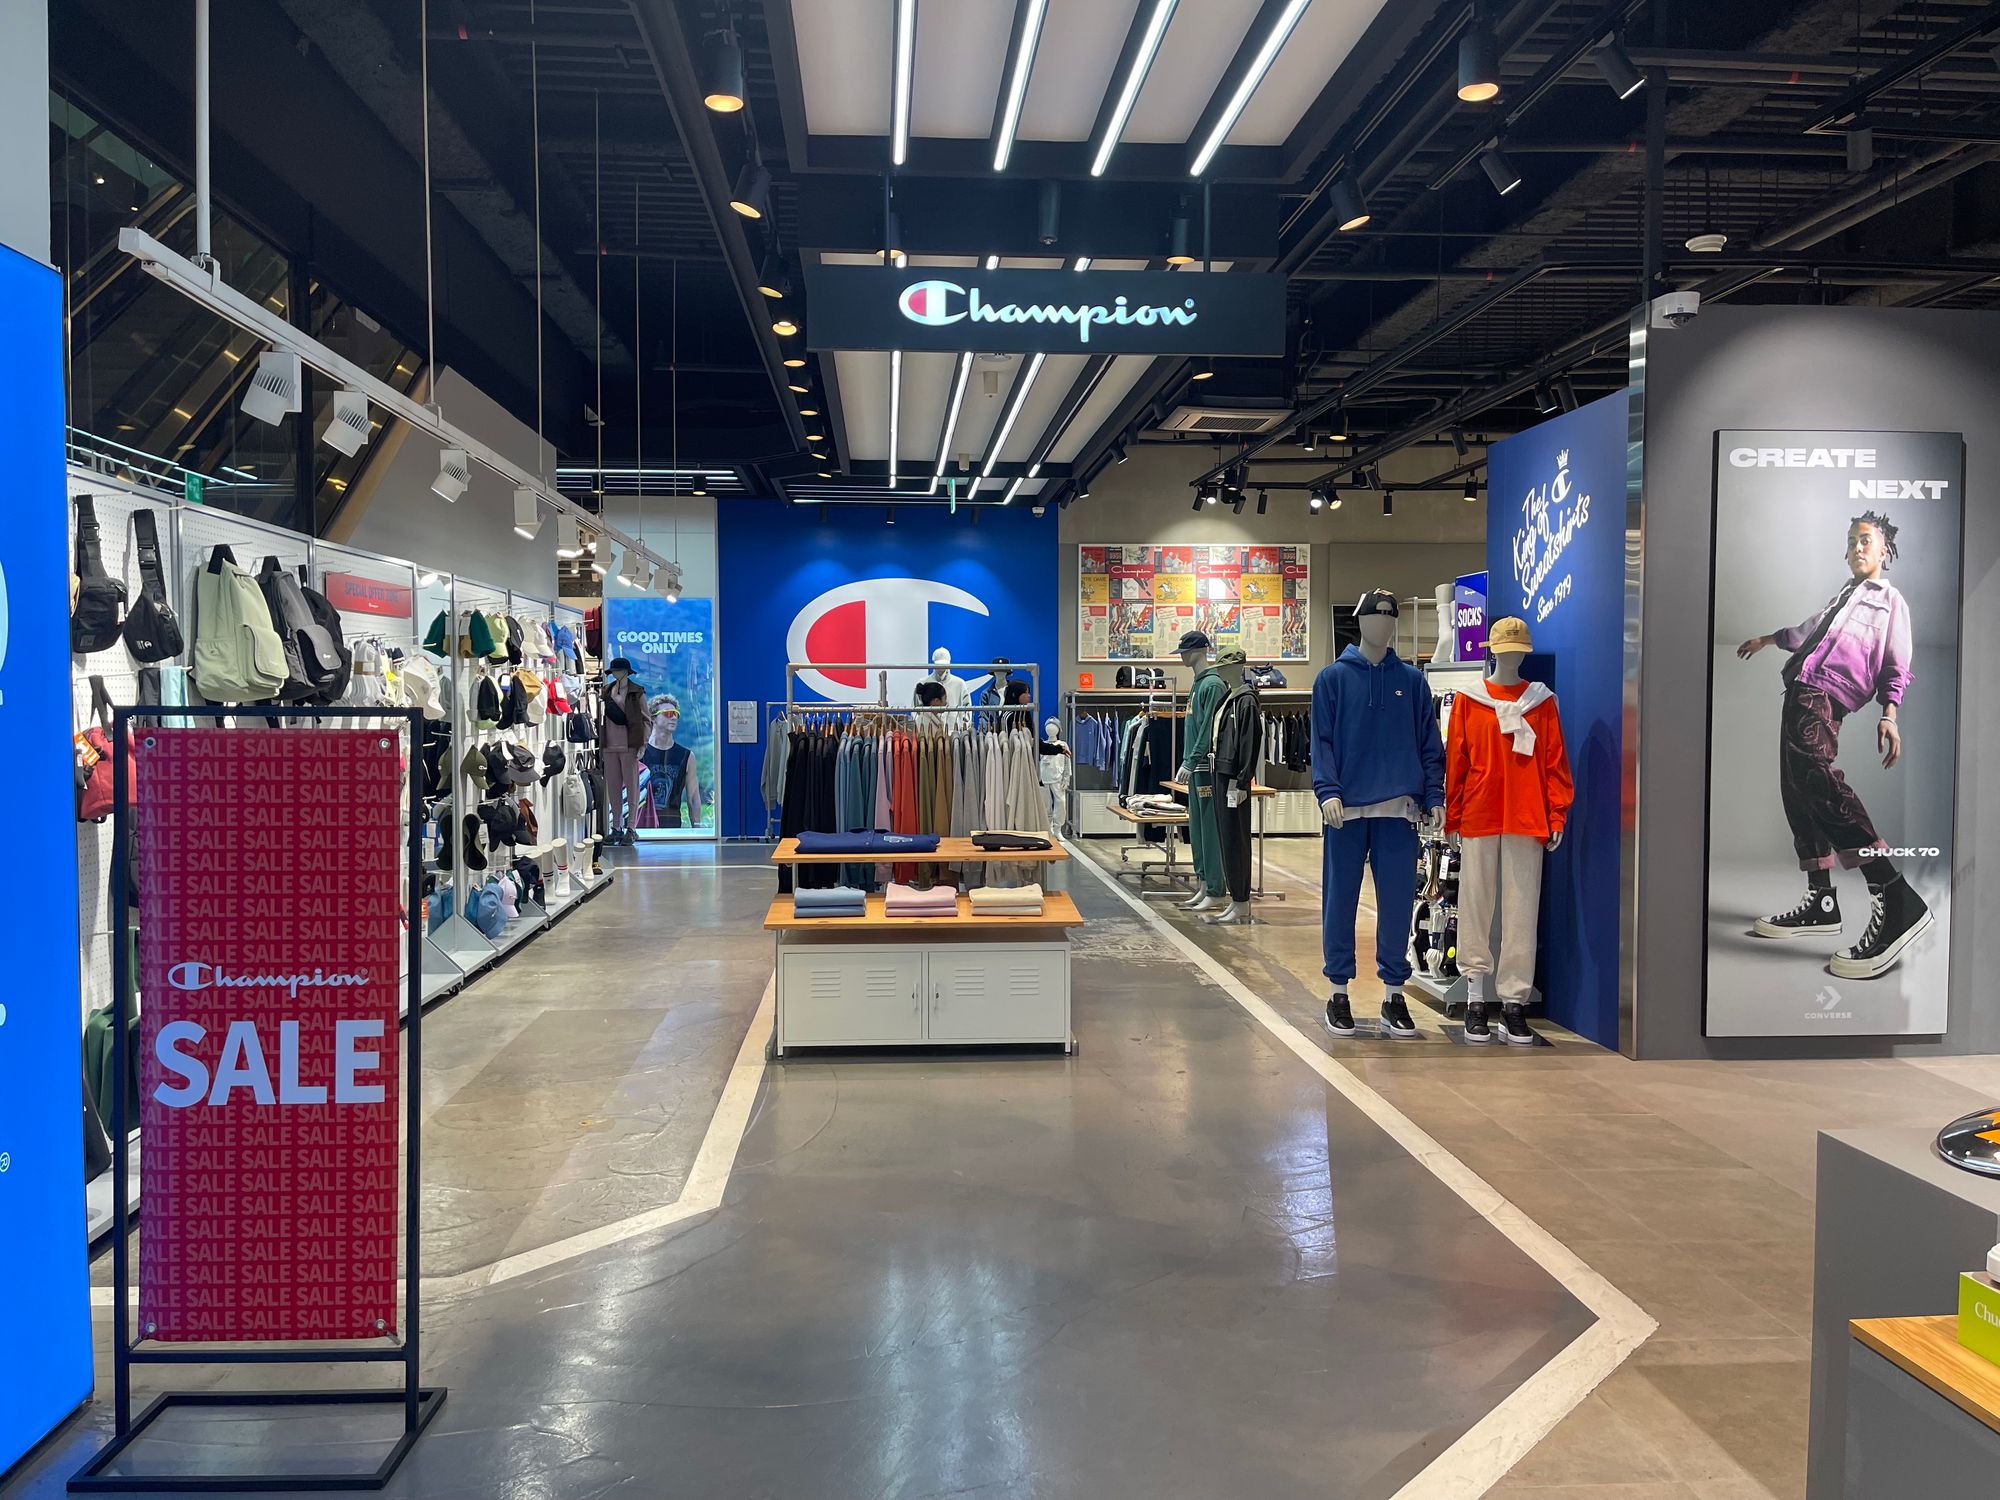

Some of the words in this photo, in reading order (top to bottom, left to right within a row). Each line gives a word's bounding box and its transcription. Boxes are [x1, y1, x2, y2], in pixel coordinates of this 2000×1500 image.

[1730, 448, 1876, 468] CREATE
[1849, 480, 1948, 500] NEXT
[1522, 488, 1542, 530] The
[1513, 525, 1536, 580] King
[1537, 483, 1550, 542] of
[1522, 493, 1590, 610] Sweatshirts
[1537, 596, 1554, 622] Since
[1554, 574, 1572, 606] 1919
[1458, 606, 1482, 627] SOCKS
[617, 631, 660, 642] GOOD
[662, 632, 704, 643] TIMES
[642, 642, 679, 654] ONLY
[187, 738, 237, 758] SALE
[244, 738, 294, 758] SALE
[300, 738, 350, 758] SALE
[187, 761, 237, 780] SALE
[244, 761, 294, 780] SALE
[300, 761, 350, 780] SALE
[187, 784, 237, 804] SALE
[244, 784, 294, 804] SALE
[299, 784, 349, 803] SALE
[187, 807, 237, 826] SALE
[244, 807, 294, 826] SALE
[299, 807, 349, 826] SALE
[187, 830, 237, 850] SALE
[243, 830, 293, 849] SALE
[299, 830, 349, 849] SALE
[187, 852, 237, 872] SALE
[243, 852, 293, 871] SALE
[299, 852, 349, 871] SALE
[1858, 847, 1916, 857] CHUCK
[187, 875, 237, 894] SALE
[243, 875, 293, 894] SALE
[299, 874, 349, 894] SALE
[187, 898, 237, 918] SALE
[243, 898, 293, 917] SALE
[299, 897, 349, 917] SALE
[186, 921, 236, 941] SALE
[243, 921, 293, 940] SALE
[298, 920, 348, 940] SALE
[186, 944, 236, 964] SALE
[243, 944, 293, 963] SALE
[298, 943, 348, 962] SALE
[186, 990, 236, 1009] SALE
[242, 989, 292, 1009] SALE
[298, 989, 348, 1008] SALE
[153, 1019, 385, 1108] SALE
[186, 1104, 236, 1124] SALE
[242, 1103, 292, 1123] SALE
[297, 1103, 347, 1122] SALE
[186, 1127, 236, 1147] SALE
[242, 1126, 292, 1146] SALE
[297, 1126, 347, 1145] SALE
[186, 1150, 236, 1170] SALE
[242, 1149, 292, 1169] SALE
[297, 1148, 347, 1168] SALE
[186, 1173, 236, 1193] SALE
[241, 1172, 291, 1192] SALE
[297, 1172, 347, 1191] SALE
[186, 1196, 236, 1216] SALE
[241, 1196, 291, 1215] SALE
[296, 1194, 346, 1214] SALE
[186, 1219, 236, 1239] SALE
[241, 1218, 291, 1238] SALE
[296, 1218, 346, 1237] SALE
[186, 1242, 236, 1262] SALE
[241, 1242, 291, 1261] SALE
[296, 1240, 346, 1260] SALE
[186, 1265, 236, 1284] SALE
[241, 1264, 291, 1284] SALE
[296, 1263, 346, 1282] SALE
[186, 1288, 236, 1307] SALE
[241, 1287, 291, 1306] SALE
[296, 1286, 346, 1306] SALE
[186, 1310, 236, 1330] SALE
[241, 1310, 291, 1329] SALE
[296, 1309, 346, 1328] SALE
